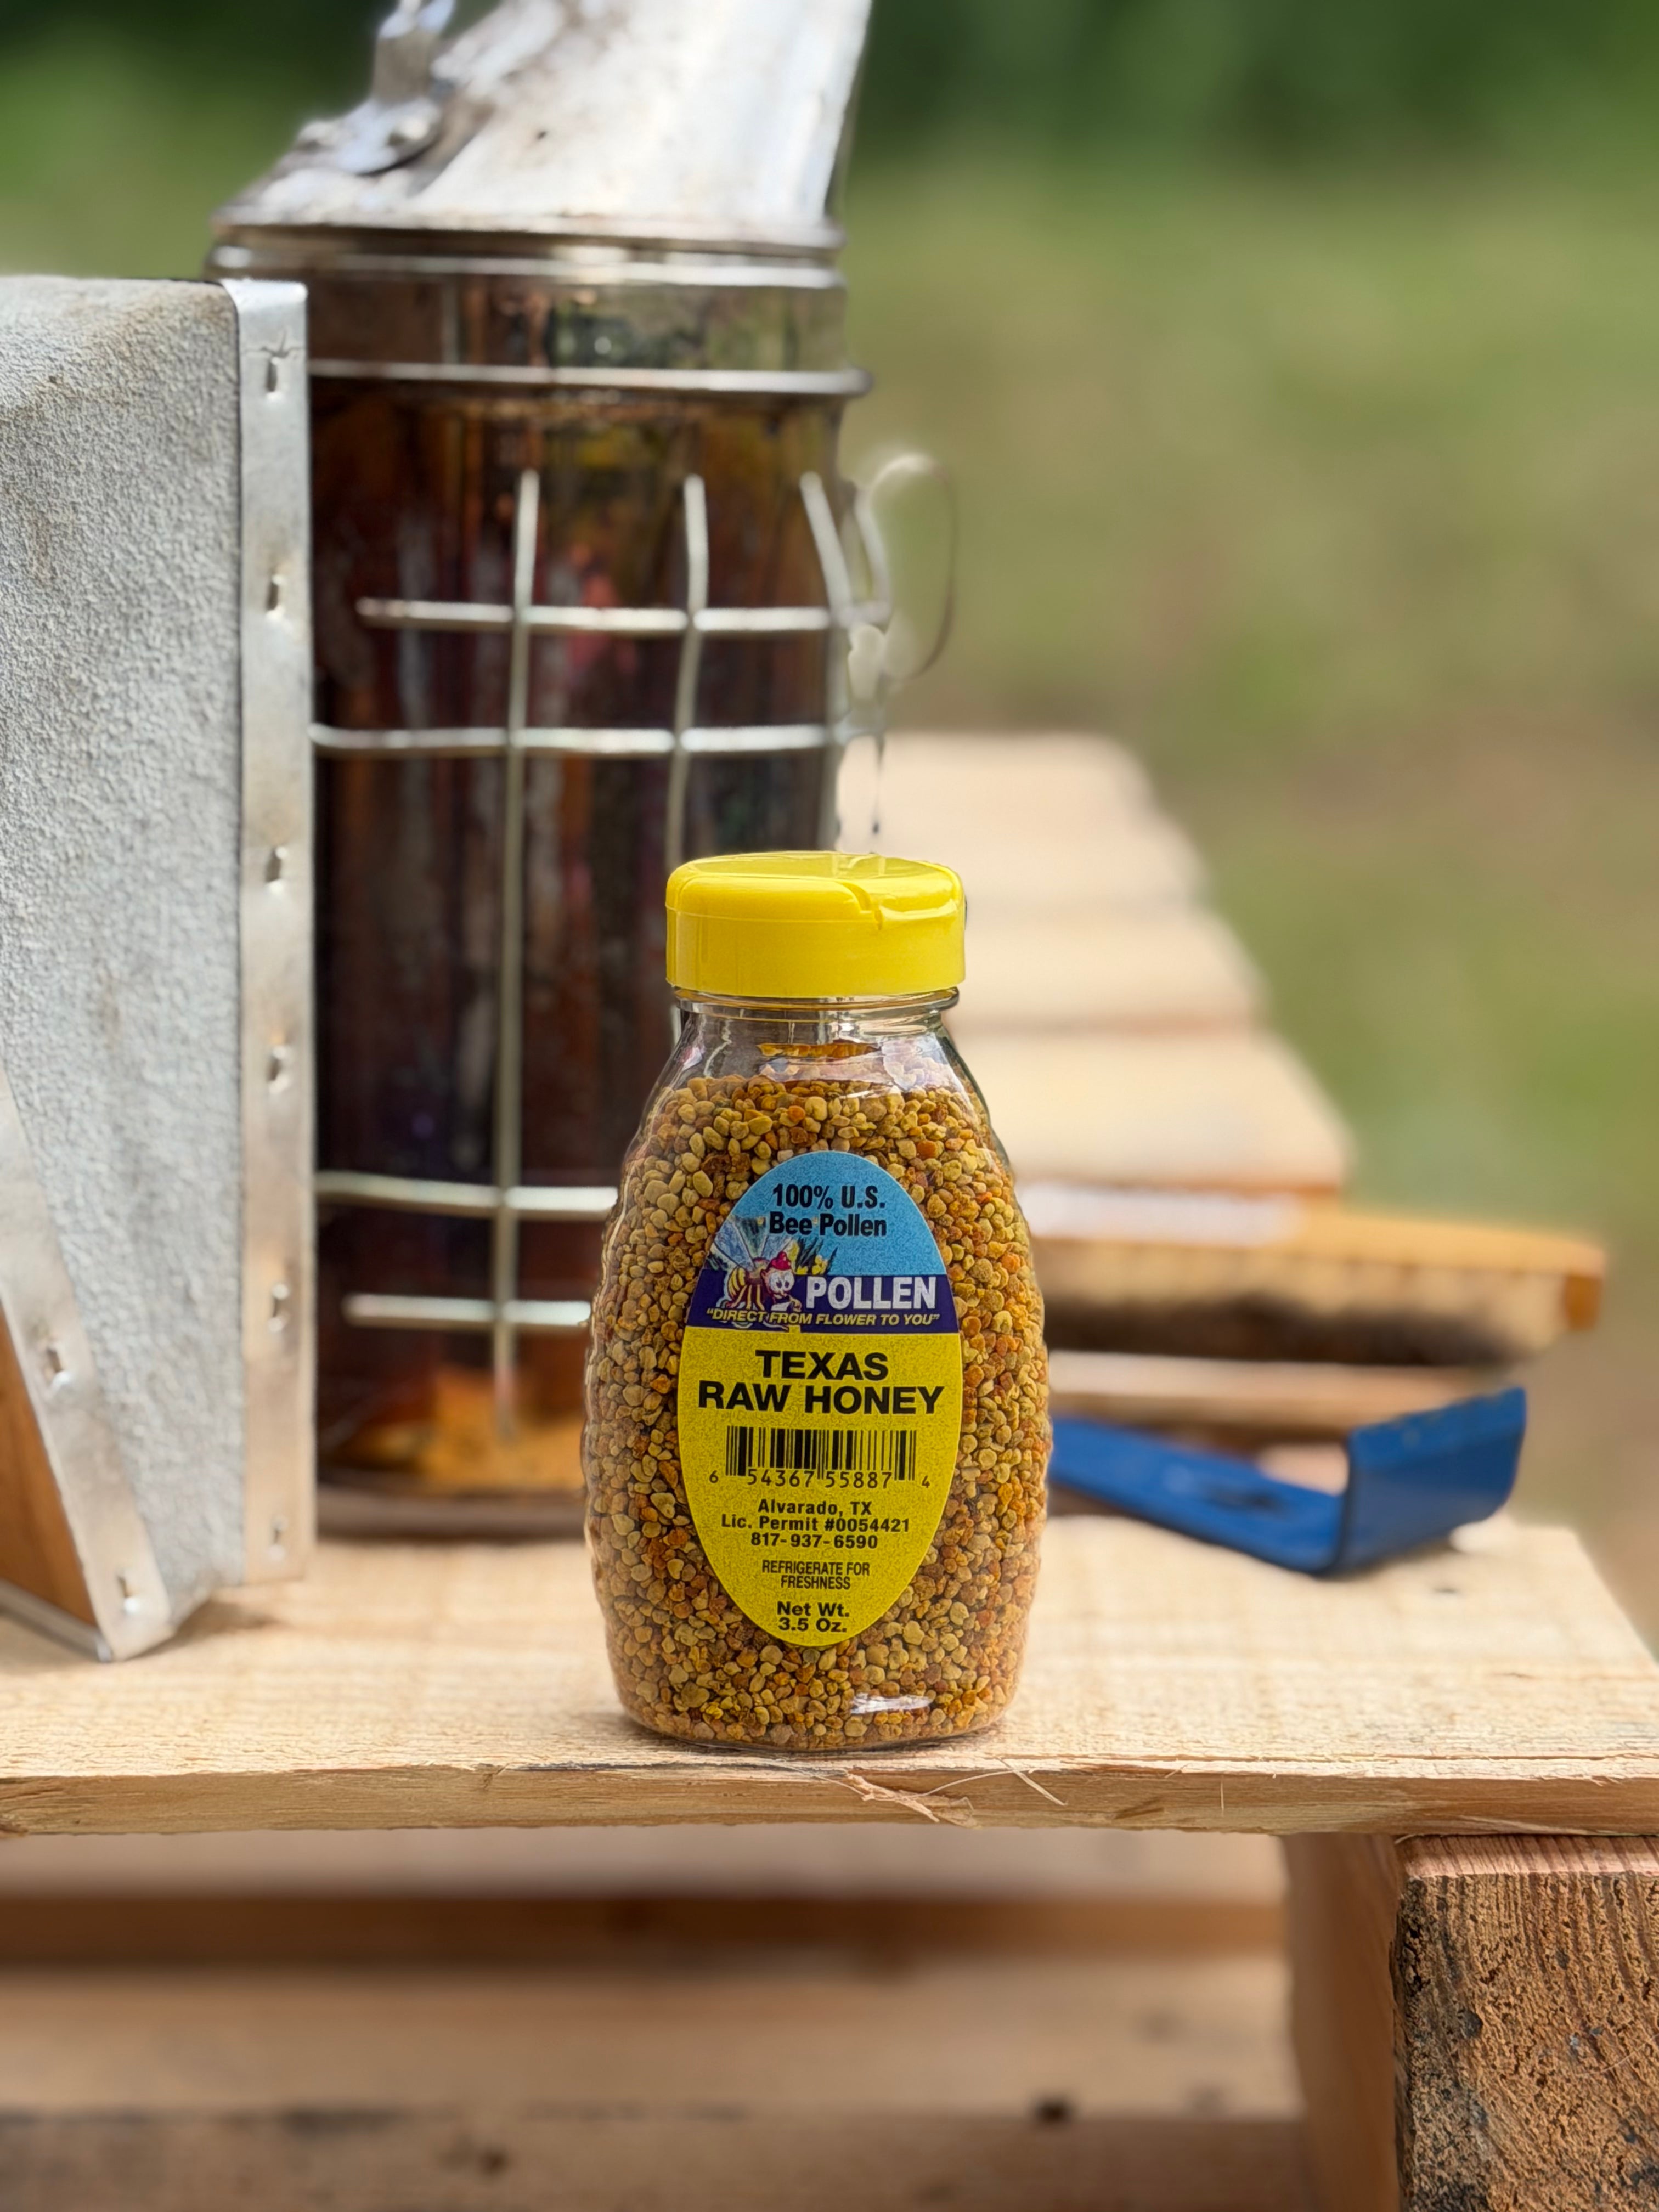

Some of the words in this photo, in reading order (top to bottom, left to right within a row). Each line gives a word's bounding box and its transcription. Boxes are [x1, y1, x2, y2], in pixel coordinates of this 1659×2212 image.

[772, 1183, 834, 1209] 100%
[841, 1186, 885, 1208] U.S.
[769, 1211, 812, 1234] Bee
[819, 1213, 887, 1237] Pollen
[806, 1277, 936, 1310] POLLEN
[769, 1312, 814, 1324] FROM
[816, 1314, 876, 1325] FLOWER
[881, 1314, 898, 1325] TO
[755, 1350, 889, 1380] TEXAS
[698, 1380, 792, 1412] RAW
[804, 1385, 944, 1414] HONEY
[709, 1470, 719, 1484] 6
[747, 1469, 813, 1488] 54367
[825, 1471, 893, 1489] 55887
[921, 1475, 930, 1488] 4
[758, 1499, 844, 1517] Alvarado,
[850, 1502, 872, 1515] TX
[721, 1514, 752, 1529] Lic.
[759, 1516, 818, 1531] Permit
[824, 1517, 909, 1532] #0054421
[751, 1532, 878, 1549] 817-937-6590
[761, 1560, 844, 1575] REFRIGERATE
[847, 1562, 870, 1576] FOR
[781, 1575, 851, 1590] FRESHNESS
[777, 1601, 811, 1617] Net
[817, 1603, 850, 1617] Wt.
[778, 1617, 809, 1631] 3.5
[816, 1618, 847, 1632] Oz.
